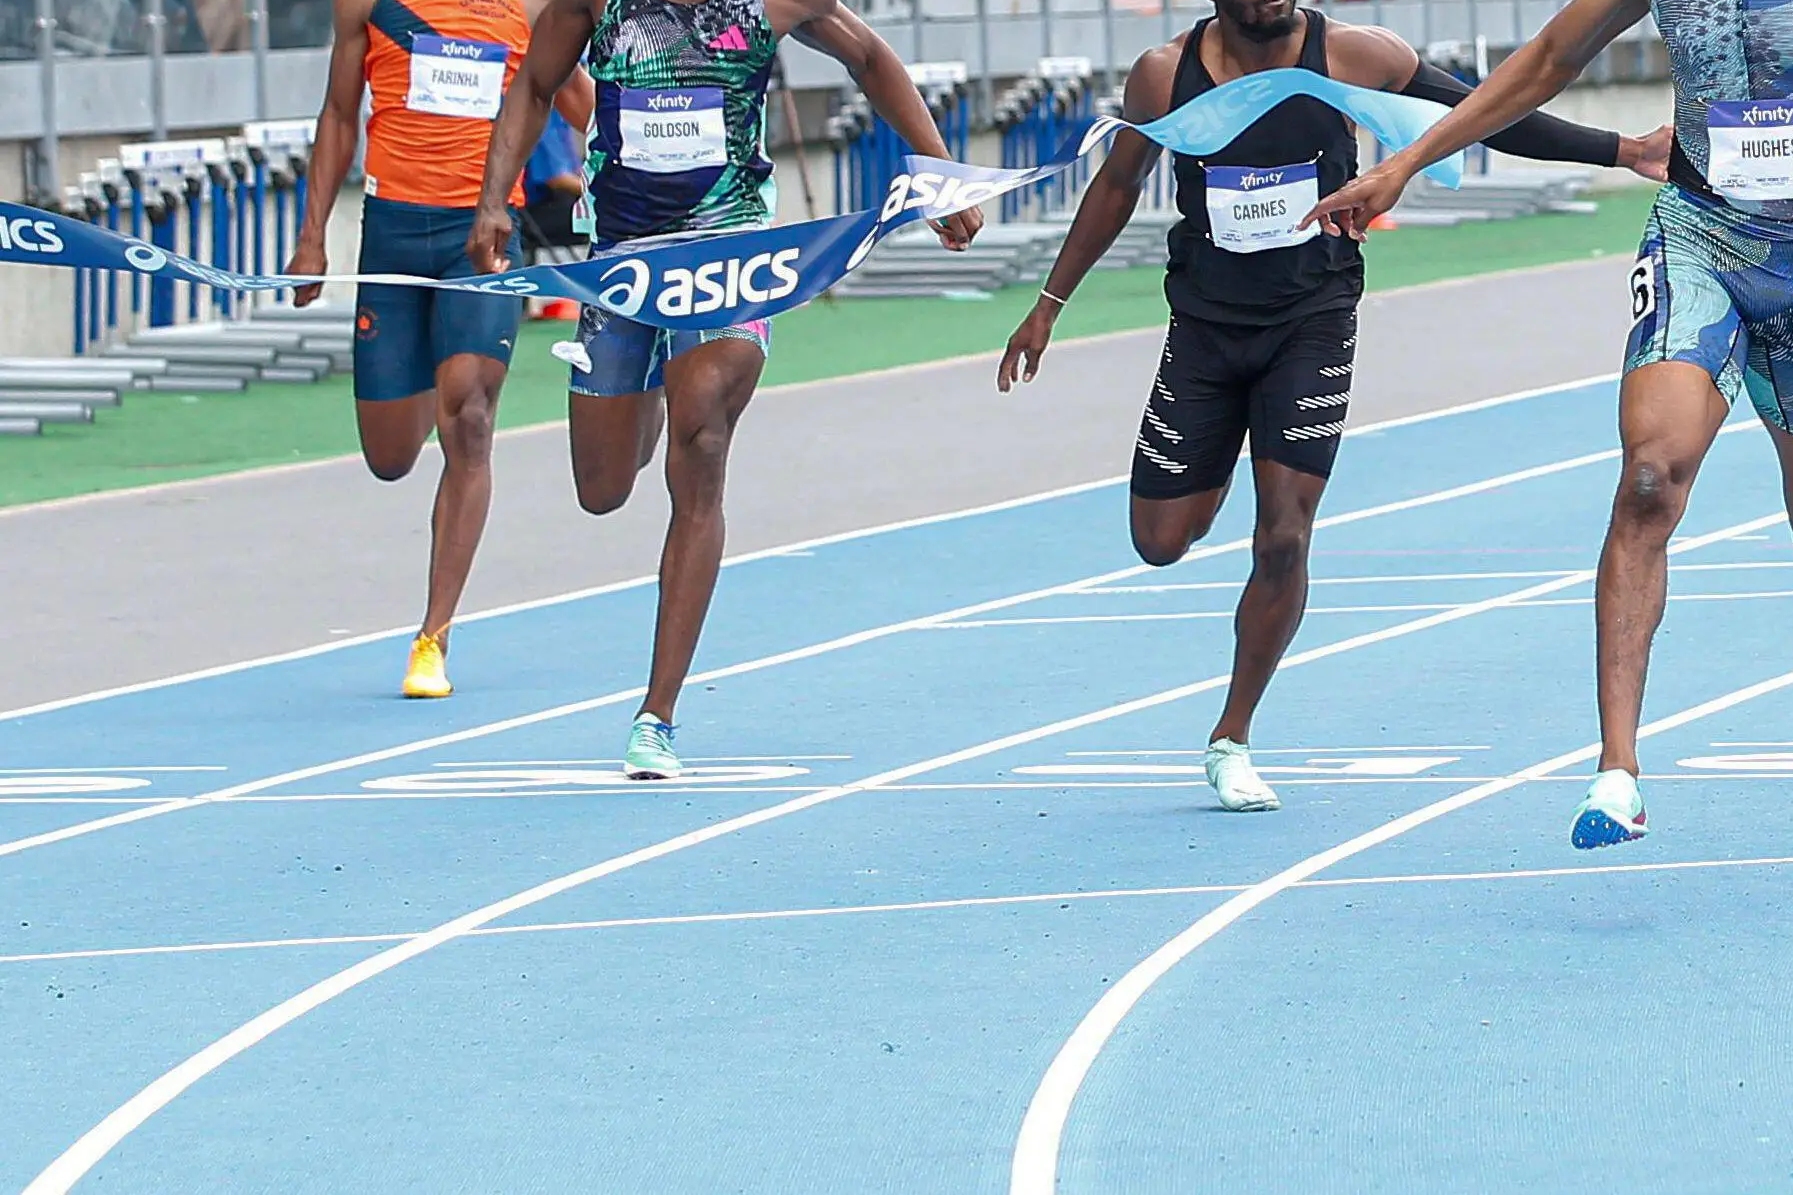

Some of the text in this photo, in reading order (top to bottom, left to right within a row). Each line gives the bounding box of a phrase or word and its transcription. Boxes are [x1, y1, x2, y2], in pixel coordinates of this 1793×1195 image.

[441, 41, 483, 59] xfinity
[432, 69, 479, 87] FARINHA
[648, 94, 693, 110] xfinity
[644, 122, 700, 138] GOLDSON
[1239, 171, 1284, 189] xfinity
[1234, 199, 1287, 220] CARNES
[0, 215, 64, 253] ics
[656, 248, 799, 316] asics
[1631, 266, 1650, 319] 6
[360, 766, 810, 789] 8
